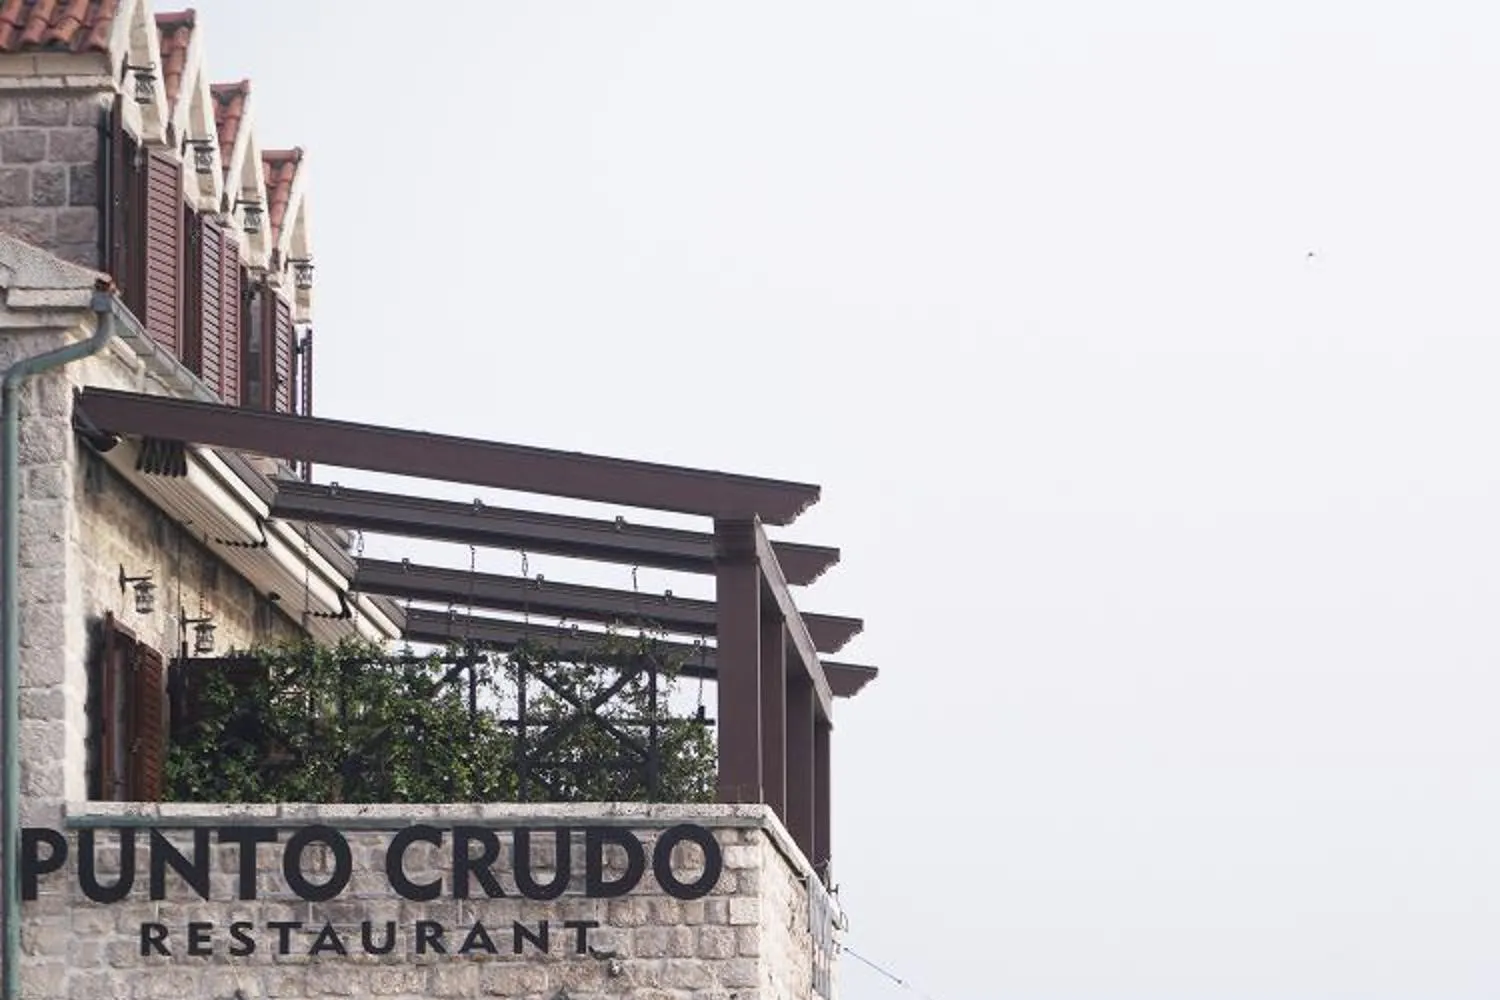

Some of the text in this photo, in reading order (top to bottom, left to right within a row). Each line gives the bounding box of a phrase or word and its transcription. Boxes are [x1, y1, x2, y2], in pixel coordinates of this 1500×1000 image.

[21, 824, 724, 901] PUNTO CRUDO
[140, 921, 600, 958] RESTAURANT
